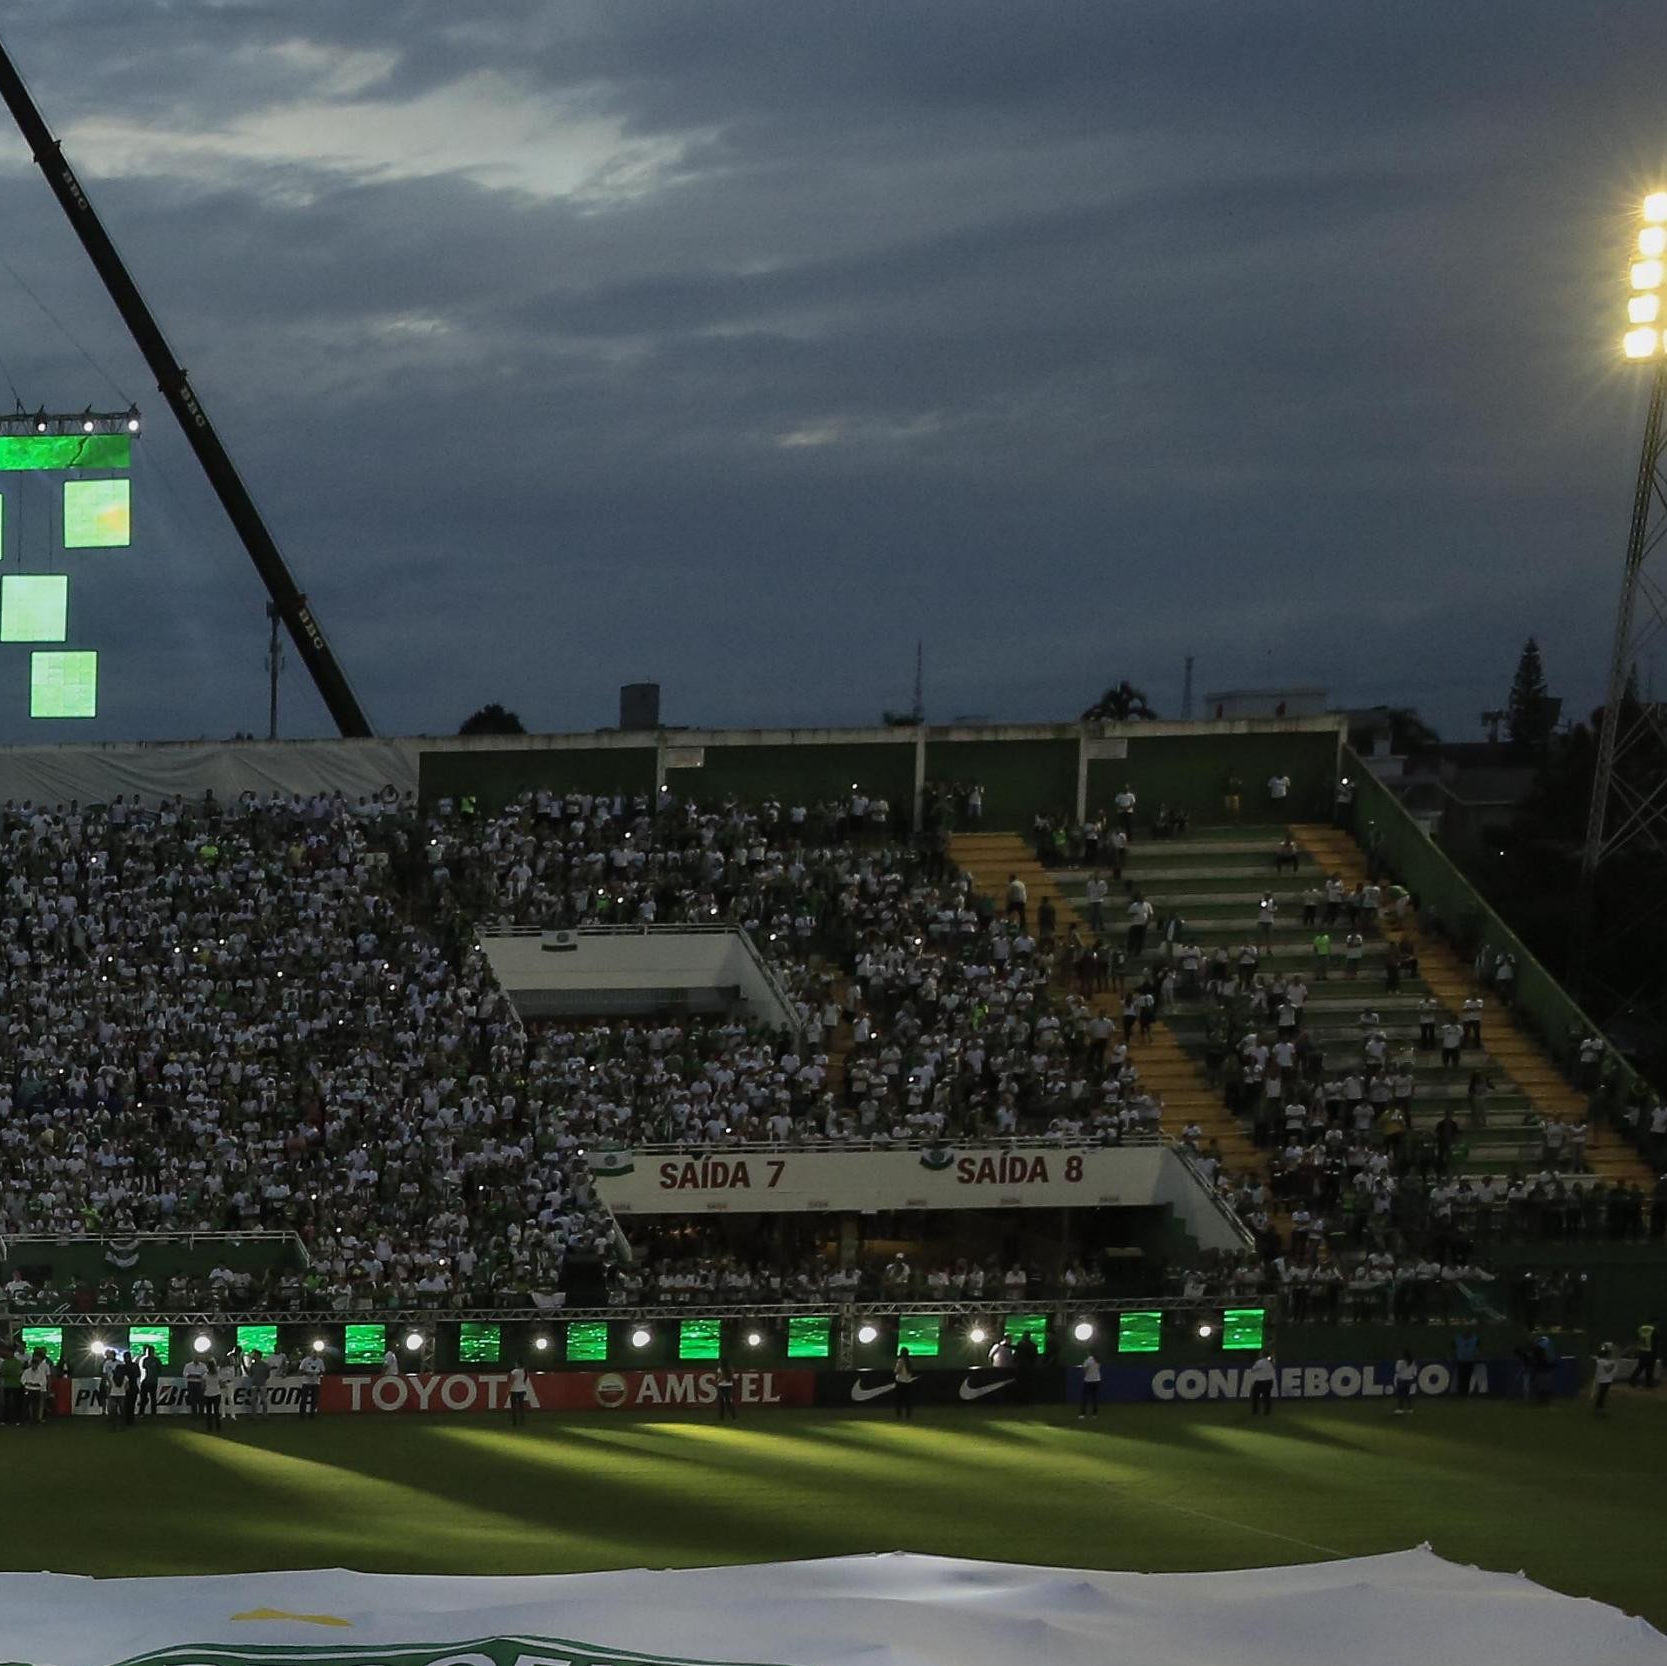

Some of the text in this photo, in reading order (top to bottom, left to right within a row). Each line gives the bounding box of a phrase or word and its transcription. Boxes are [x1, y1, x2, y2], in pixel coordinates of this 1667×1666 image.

[659, 1155, 785, 1189] SAÍDA 7
[957, 1151, 1083, 1184] SAÍDA 8
